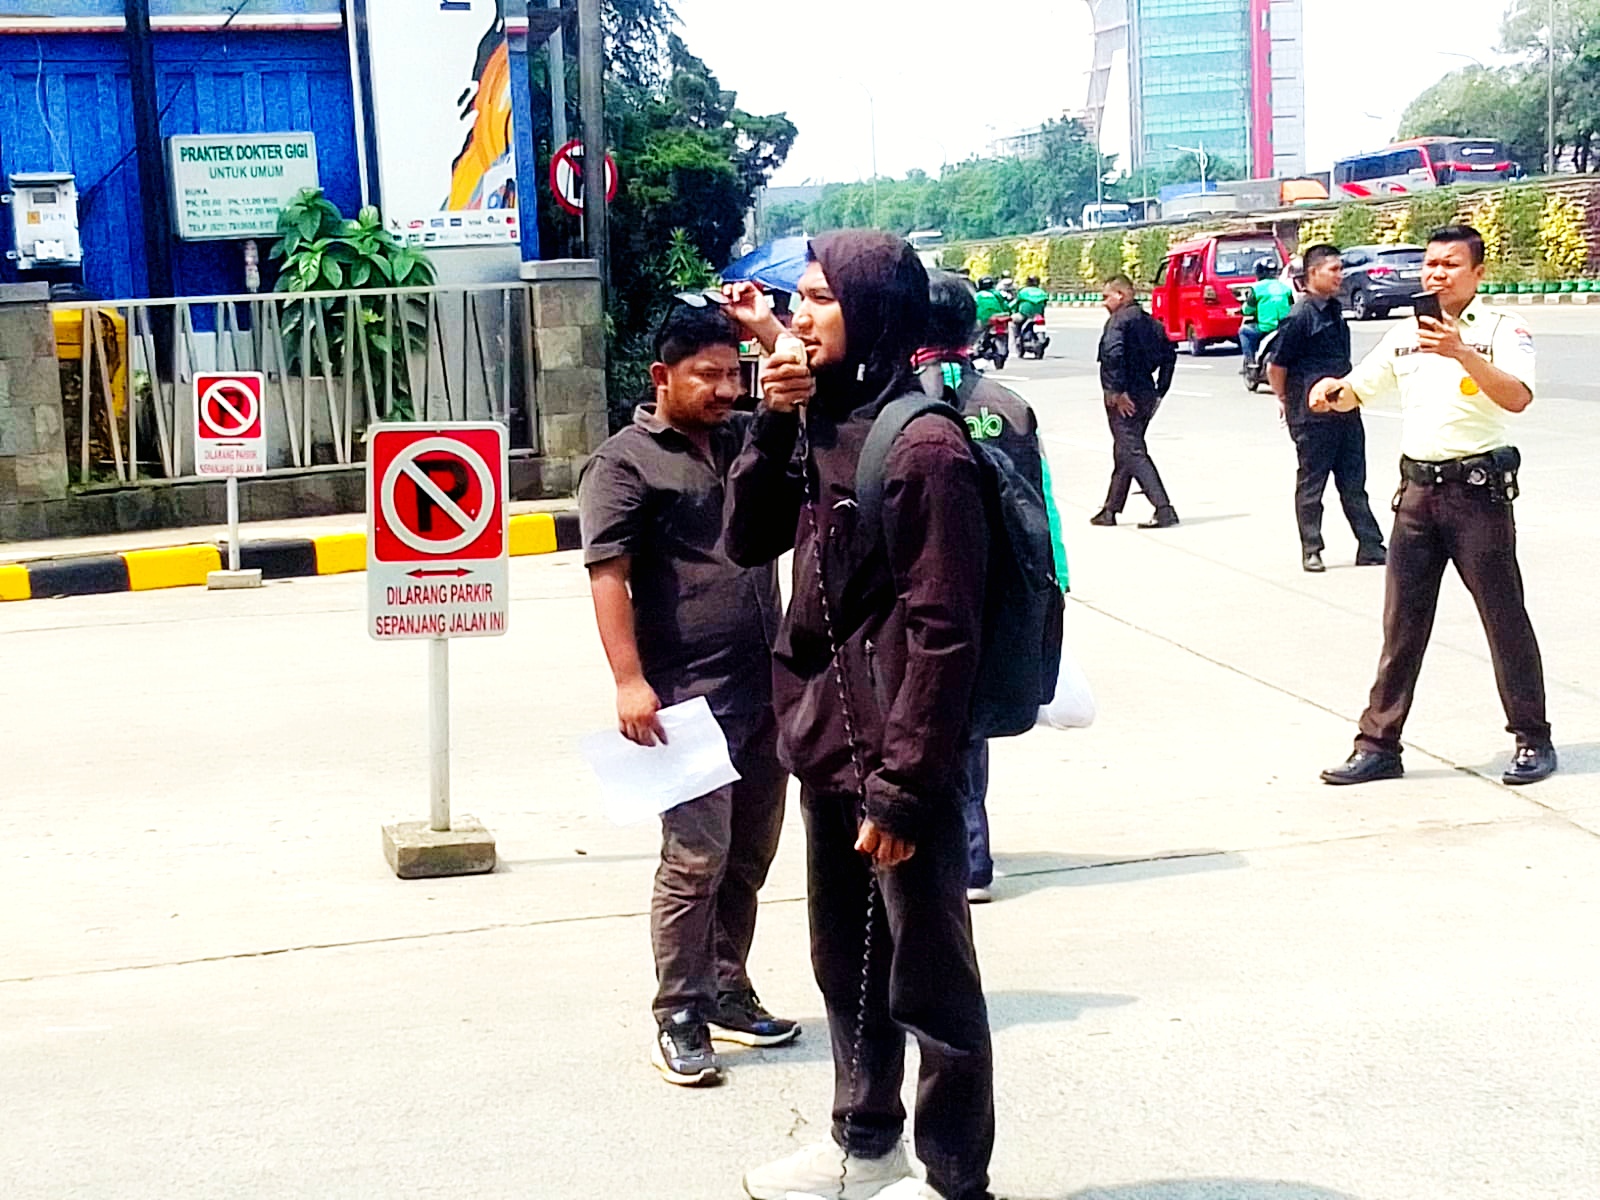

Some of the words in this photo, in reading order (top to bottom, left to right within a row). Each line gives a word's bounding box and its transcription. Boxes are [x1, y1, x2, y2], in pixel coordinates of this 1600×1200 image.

[180, 145, 234, 162] PRAKTEK
[237, 144, 283, 160] DOKTER
[285, 143, 309, 159] GIGI
[209, 166, 247, 179] UNTUK
[250, 165, 284, 178] UMUM
[964, 407, 1003, 440] ab
[386, 585, 447, 606] DILARANG
[450, 583, 493, 603] PARKIR
[376, 614, 446, 635] SEPANJANG
[449, 612, 487, 632] JALAN
[490, 611, 504, 631] INI
